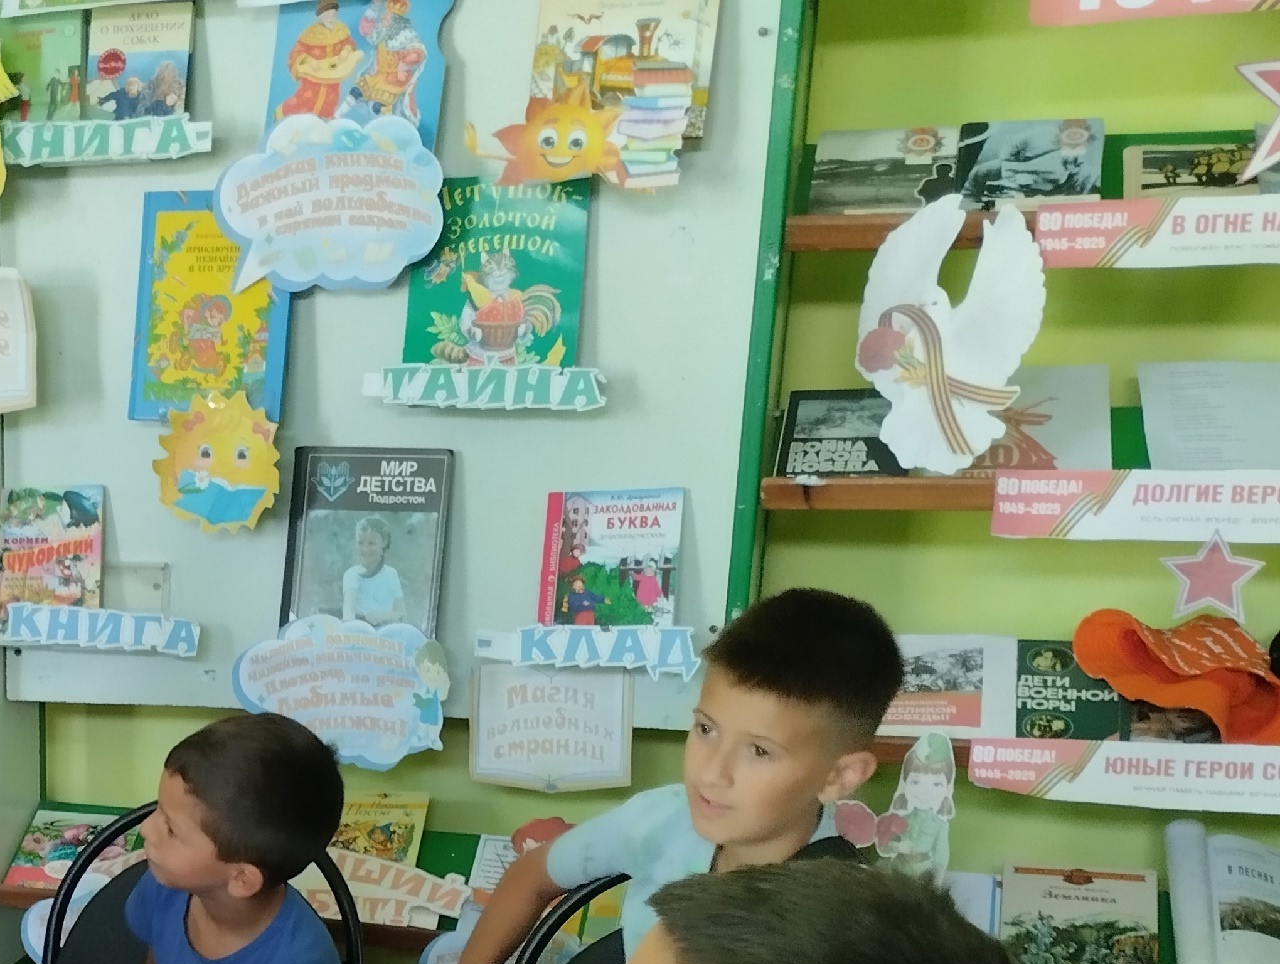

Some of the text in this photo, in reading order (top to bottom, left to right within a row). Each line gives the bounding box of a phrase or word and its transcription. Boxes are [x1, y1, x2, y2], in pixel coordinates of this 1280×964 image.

[113, 22, 185, 35] ПОХИЩЕНИИ
[122, 35, 160, 46] СОБАК
[446, 204, 557, 238] ЗОЛОТОЙ
[1039, 212, 1128, 231] 80 ПОБЕДА!
[1172, 215, 1186, 235] В
[1195, 213, 1253, 234] ОГНЕ
[382, 355, 601, 406] ТАЙНА
[788, 450, 867, 462] НАРОД
[380, 460, 418, 476] МИР
[786, 460, 880, 473] ПОБЕДА
[356, 476, 436, 493] ДЕТСТВА
[997, 477, 1083, 496] 80 ПОБЕДА!
[1132, 483, 1224, 506] ДОЛГИЕ
[593, 501, 677, 515] ЗАКОЛДОВАННАЯ
[606, 516, 661, 530] БУКВА
[6, 535, 94, 573] ЧУКОВСКИЙ
[8, 605, 197, 653] КНИГА
[1020, 674, 1070, 687] ДЕТИ
[506, 683, 596, 711] Магия
[1017, 686, 1119, 702] ВОЕННОЙ
[1017, 698, 1076, 712] ПОРЫ
[486, 707, 614, 742] волшебных
[493, 738, 605, 763] страниц
[972, 745, 1056, 764] 80 ПОБЕДА!
[1104, 755, 1175, 778] ЮНЫЕ
[1183, 759, 1254, 781] ГЕРОИ
